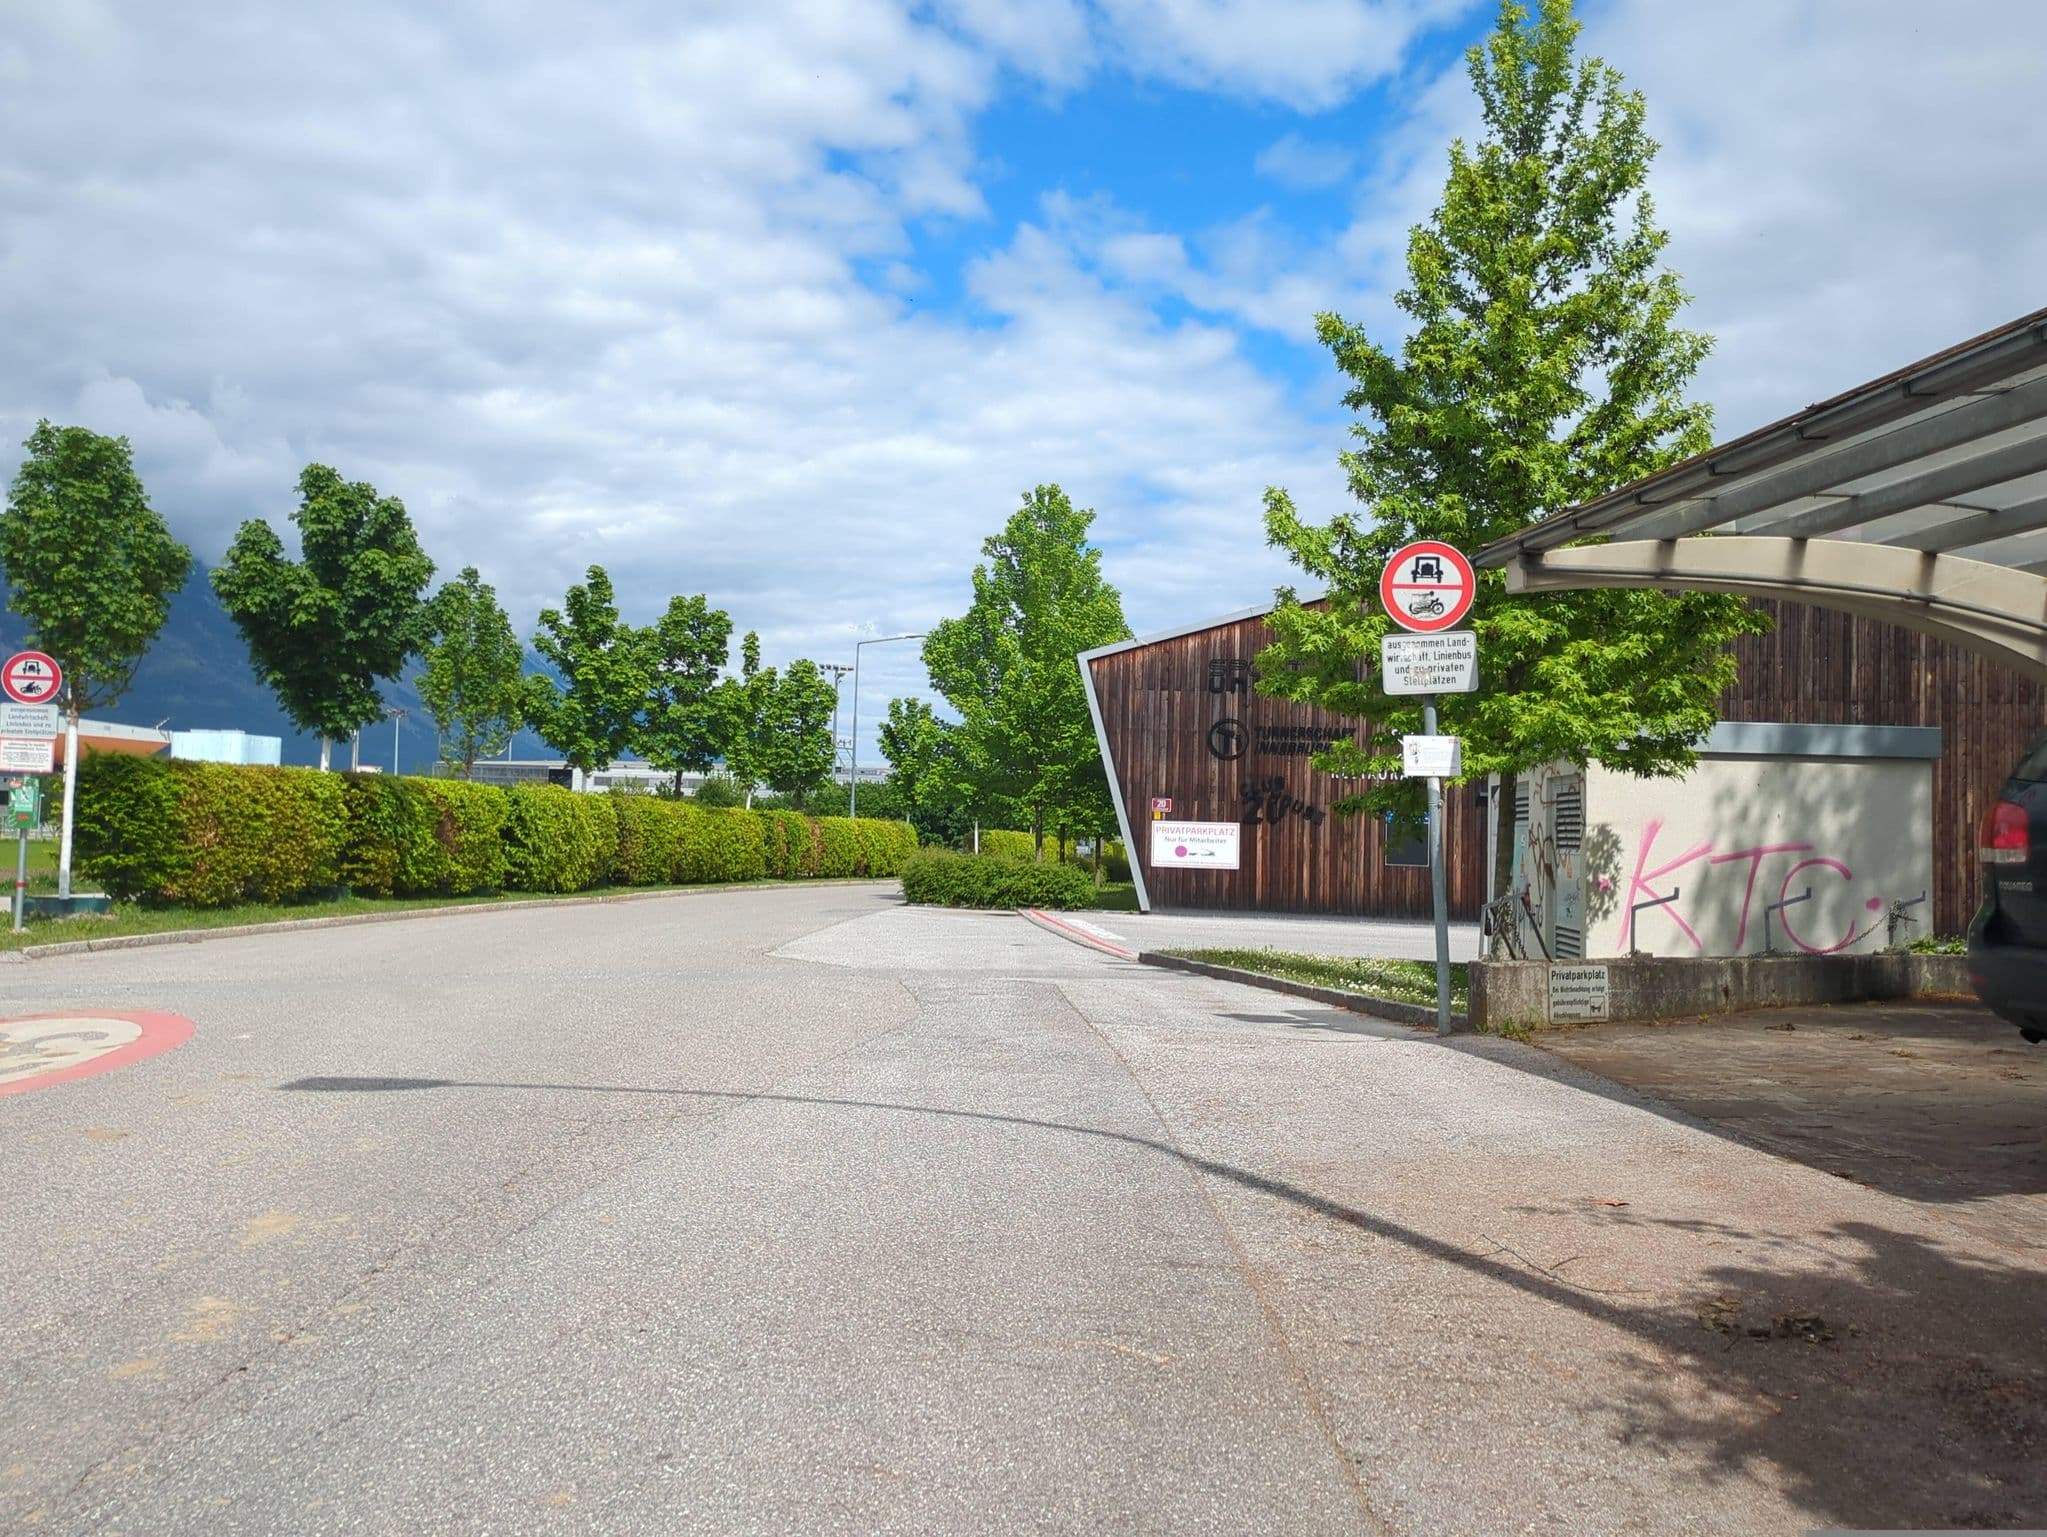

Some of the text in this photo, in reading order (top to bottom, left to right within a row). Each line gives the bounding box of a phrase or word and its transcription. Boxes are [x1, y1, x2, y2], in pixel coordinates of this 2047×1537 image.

[1447, 637, 1470, 647] Land-
[1433, 650, 1472, 661] Linienbus
[1394, 664, 1410, 674] und
[1427, 663, 1465, 674] privaten
[1155, 826, 1236, 837] PRIVATPARKPLATZ
[1551, 970, 1605, 982] Privatparkplatz
